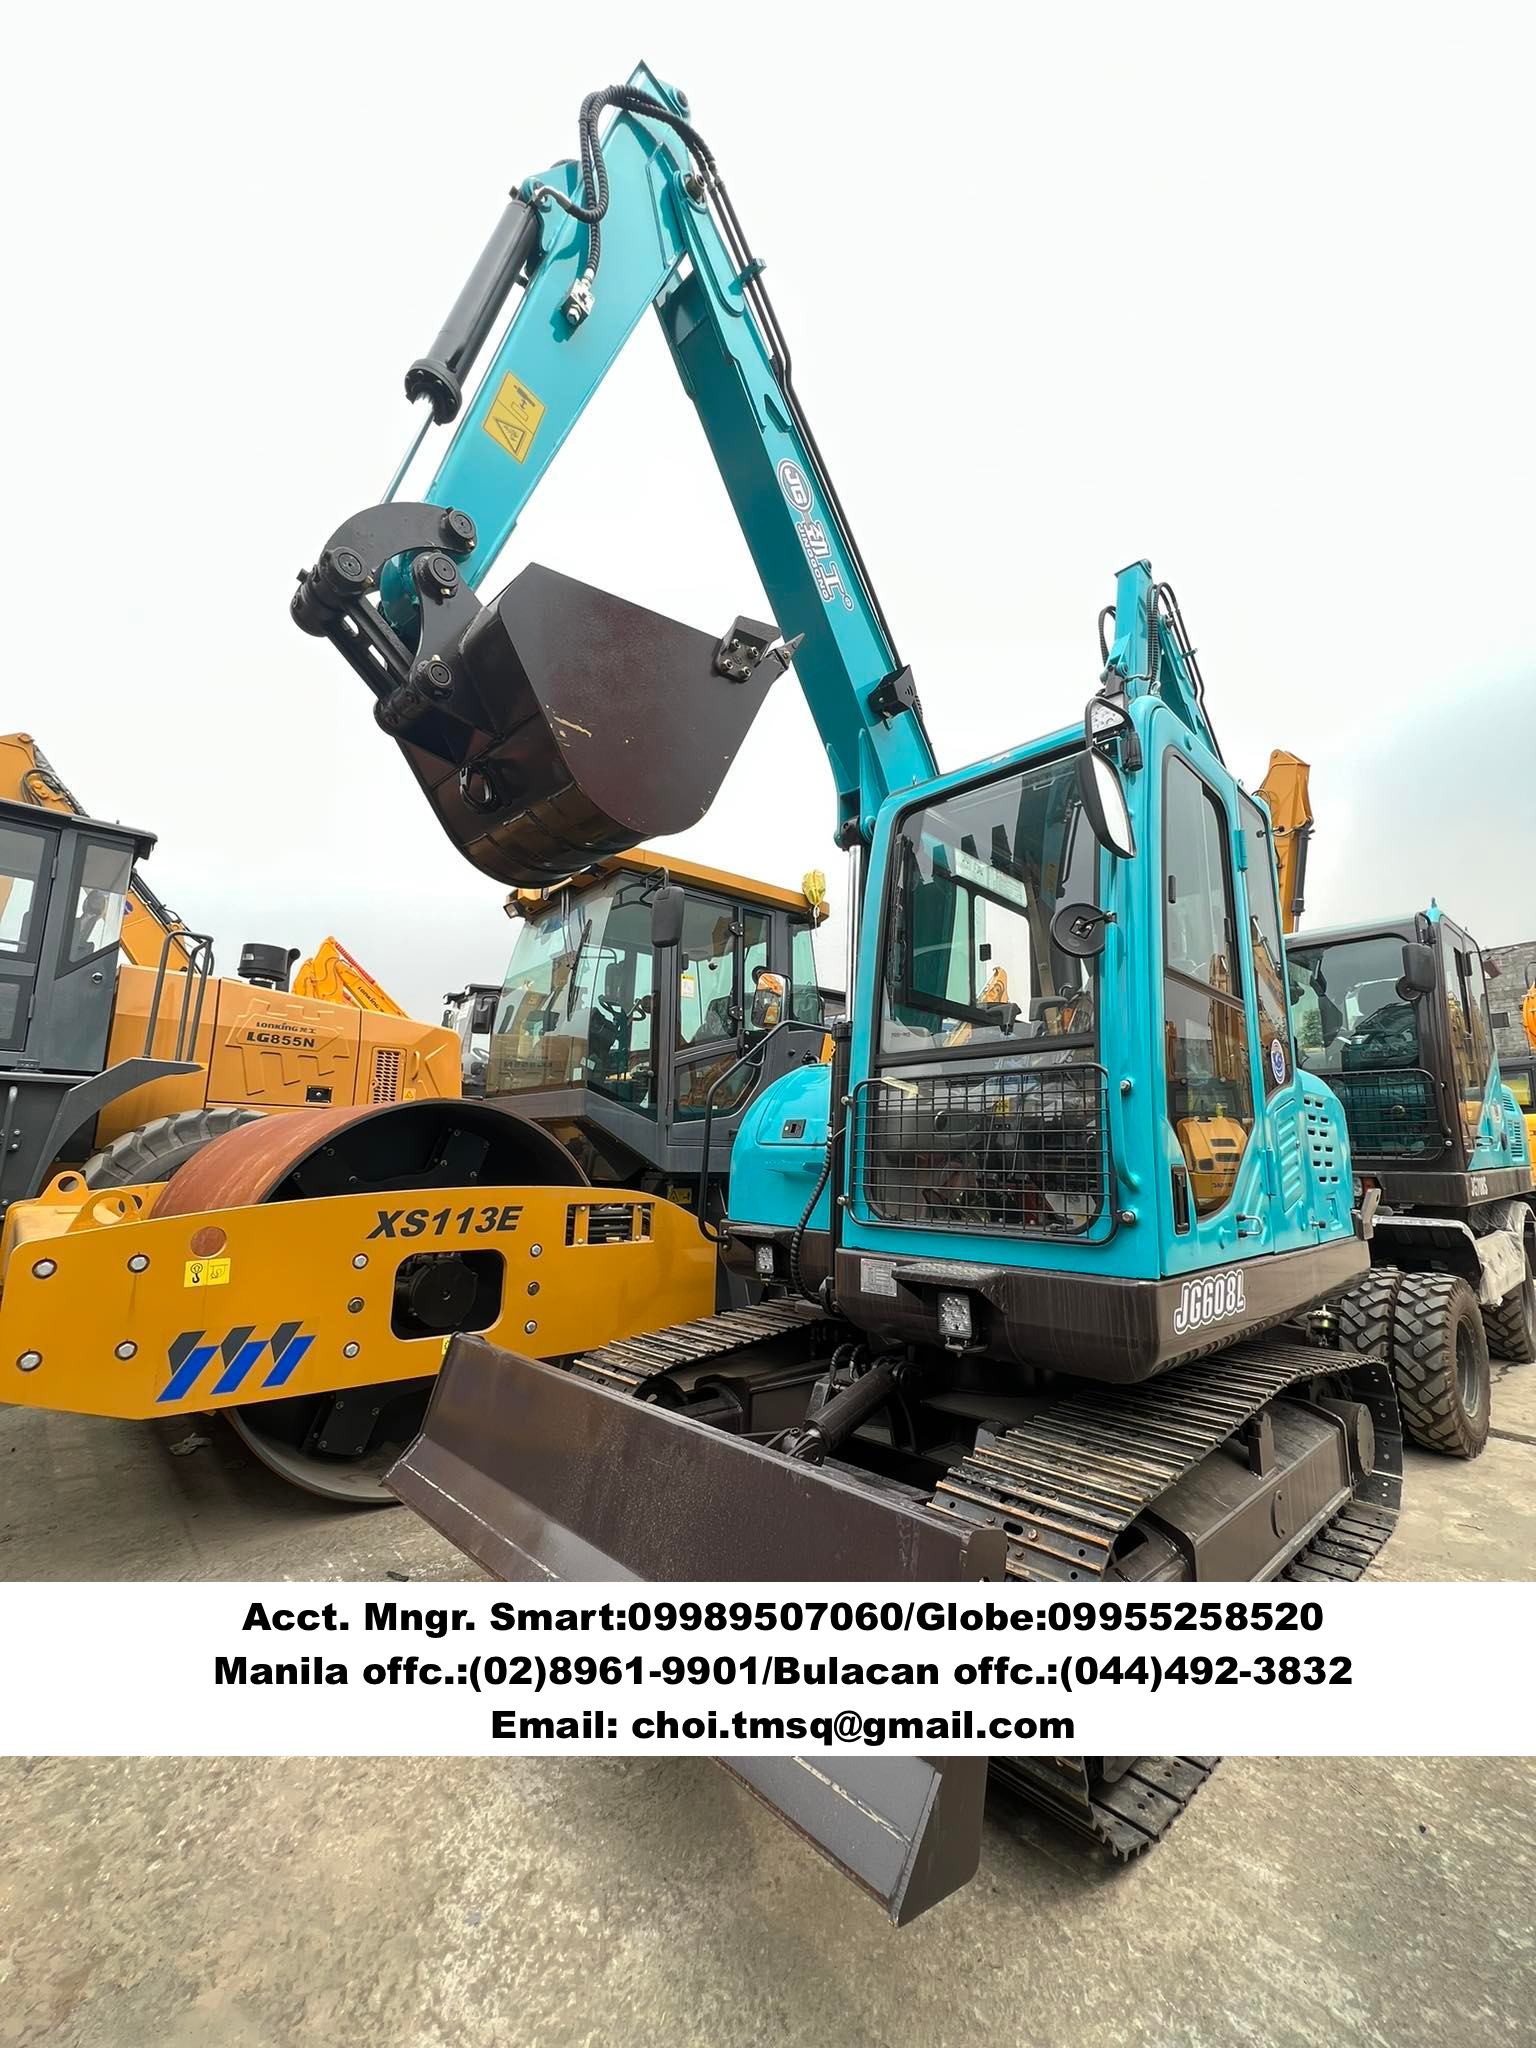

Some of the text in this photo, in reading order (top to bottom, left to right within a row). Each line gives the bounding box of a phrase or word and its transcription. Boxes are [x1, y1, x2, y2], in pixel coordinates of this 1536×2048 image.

[784, 467, 808, 506] JG
[797, 523, 830, 600] JINGGONG
[246, 1031, 315, 1048] LG855N
[366, 1205, 524, 1240] XS113E
[1175, 1270, 1245, 1334] JG608L
